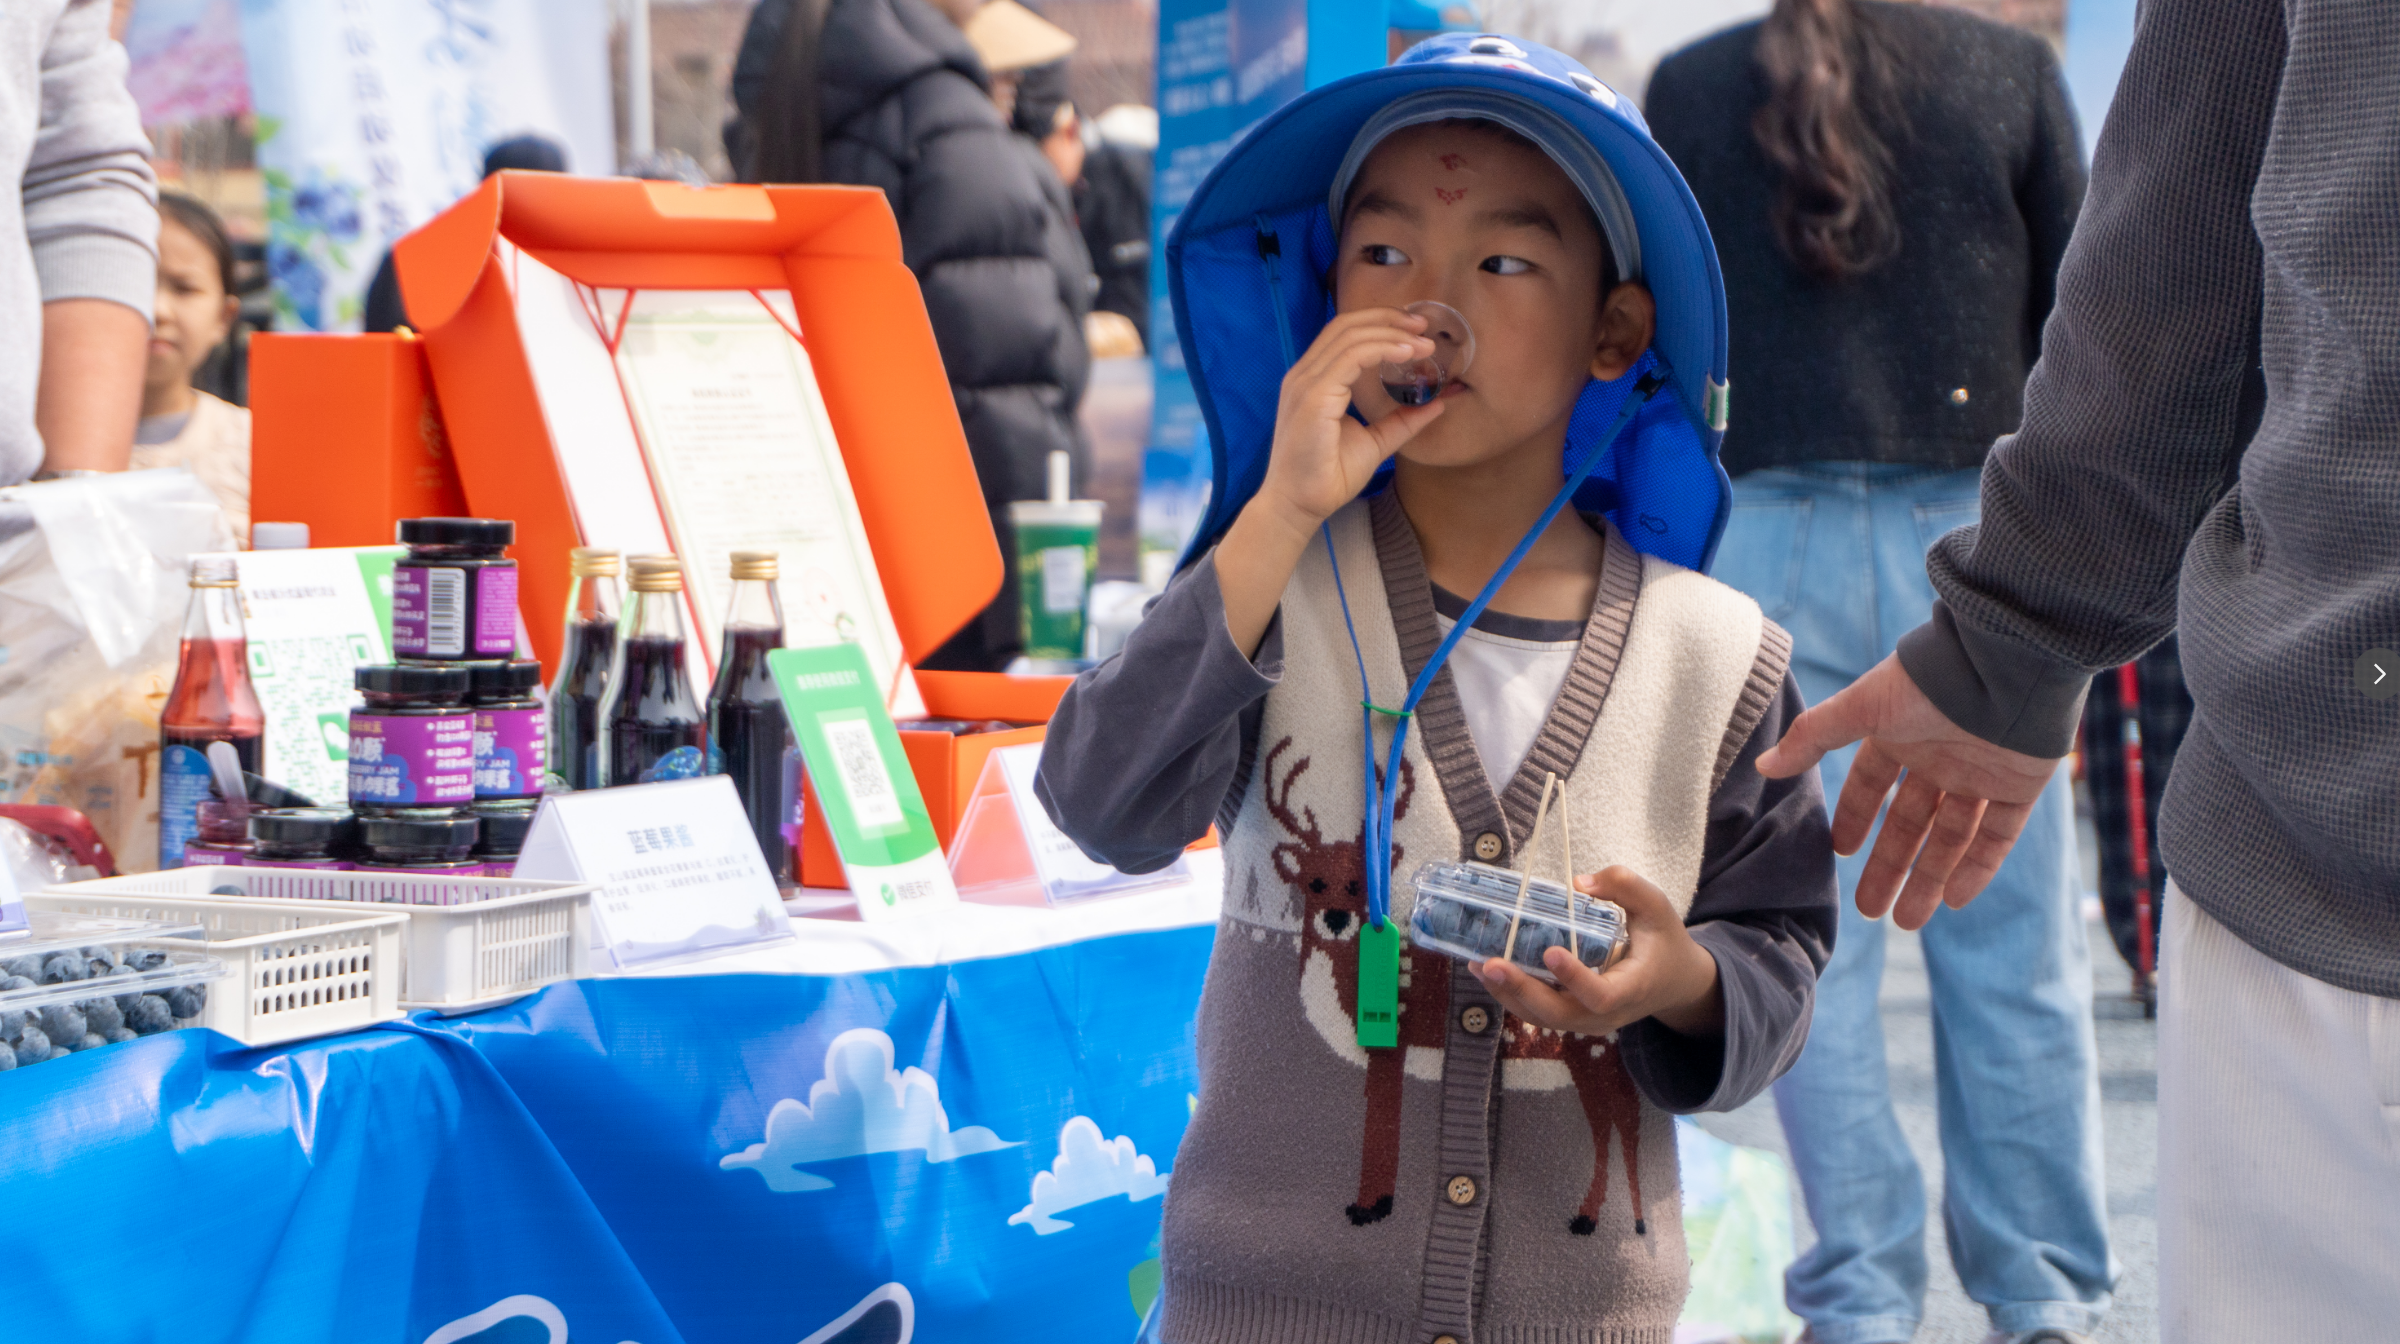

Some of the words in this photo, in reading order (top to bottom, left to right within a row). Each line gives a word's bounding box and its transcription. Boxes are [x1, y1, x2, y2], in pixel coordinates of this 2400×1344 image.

[378, 766, 400, 776] JAM
[489, 759, 511, 768] JAM
[627, 823, 695, 854] 蓝莓果酱
[896, 878, 935, 901] 微信支付
